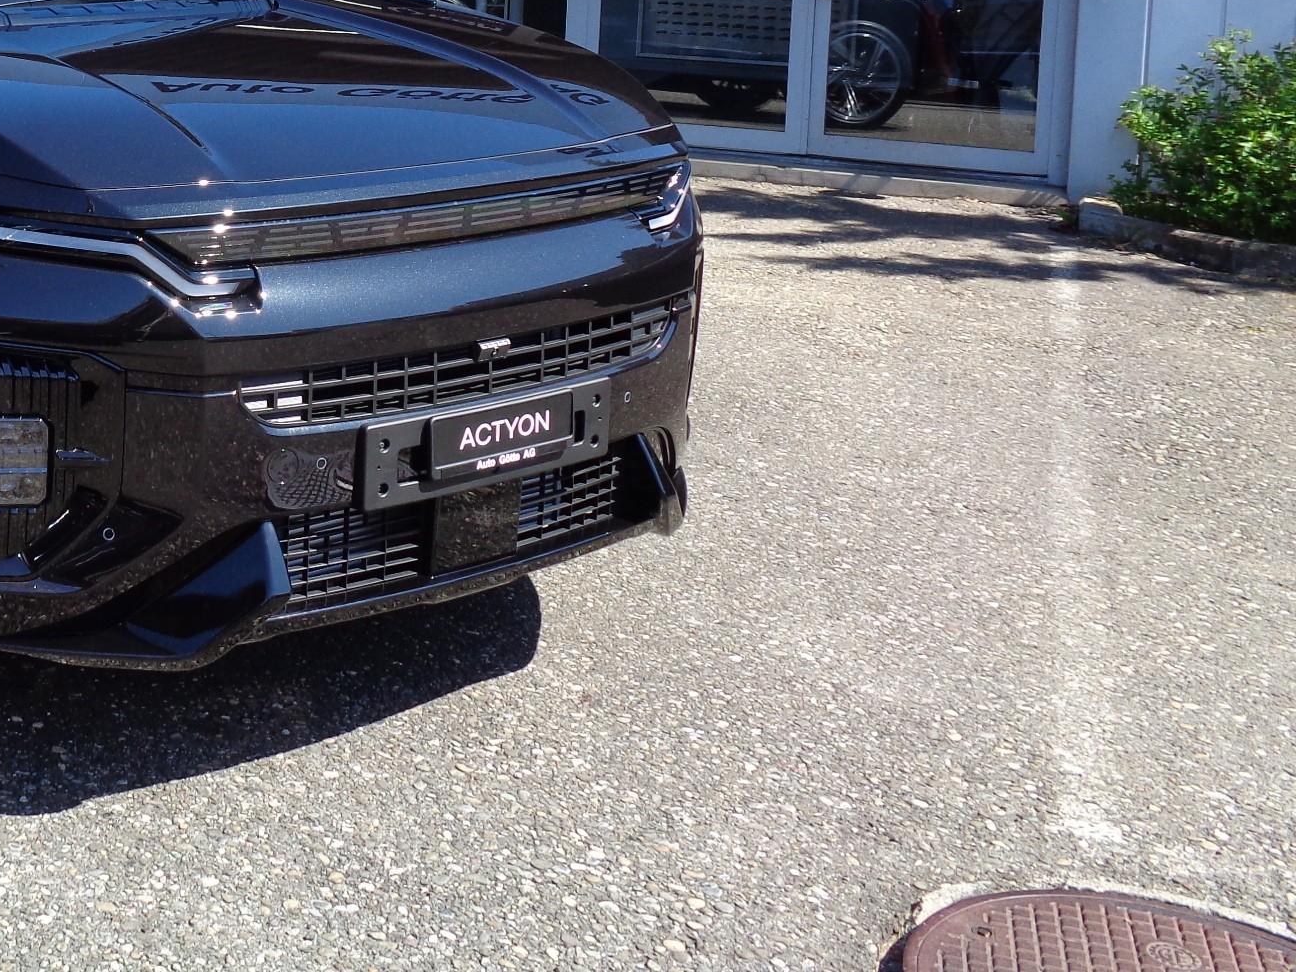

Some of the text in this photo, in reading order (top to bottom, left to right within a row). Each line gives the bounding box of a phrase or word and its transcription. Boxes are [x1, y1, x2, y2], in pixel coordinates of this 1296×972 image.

[459, 409, 550, 450] ACTYON
[476, 459, 496, 470] Auto
[523, 447, 536, 459] AG
